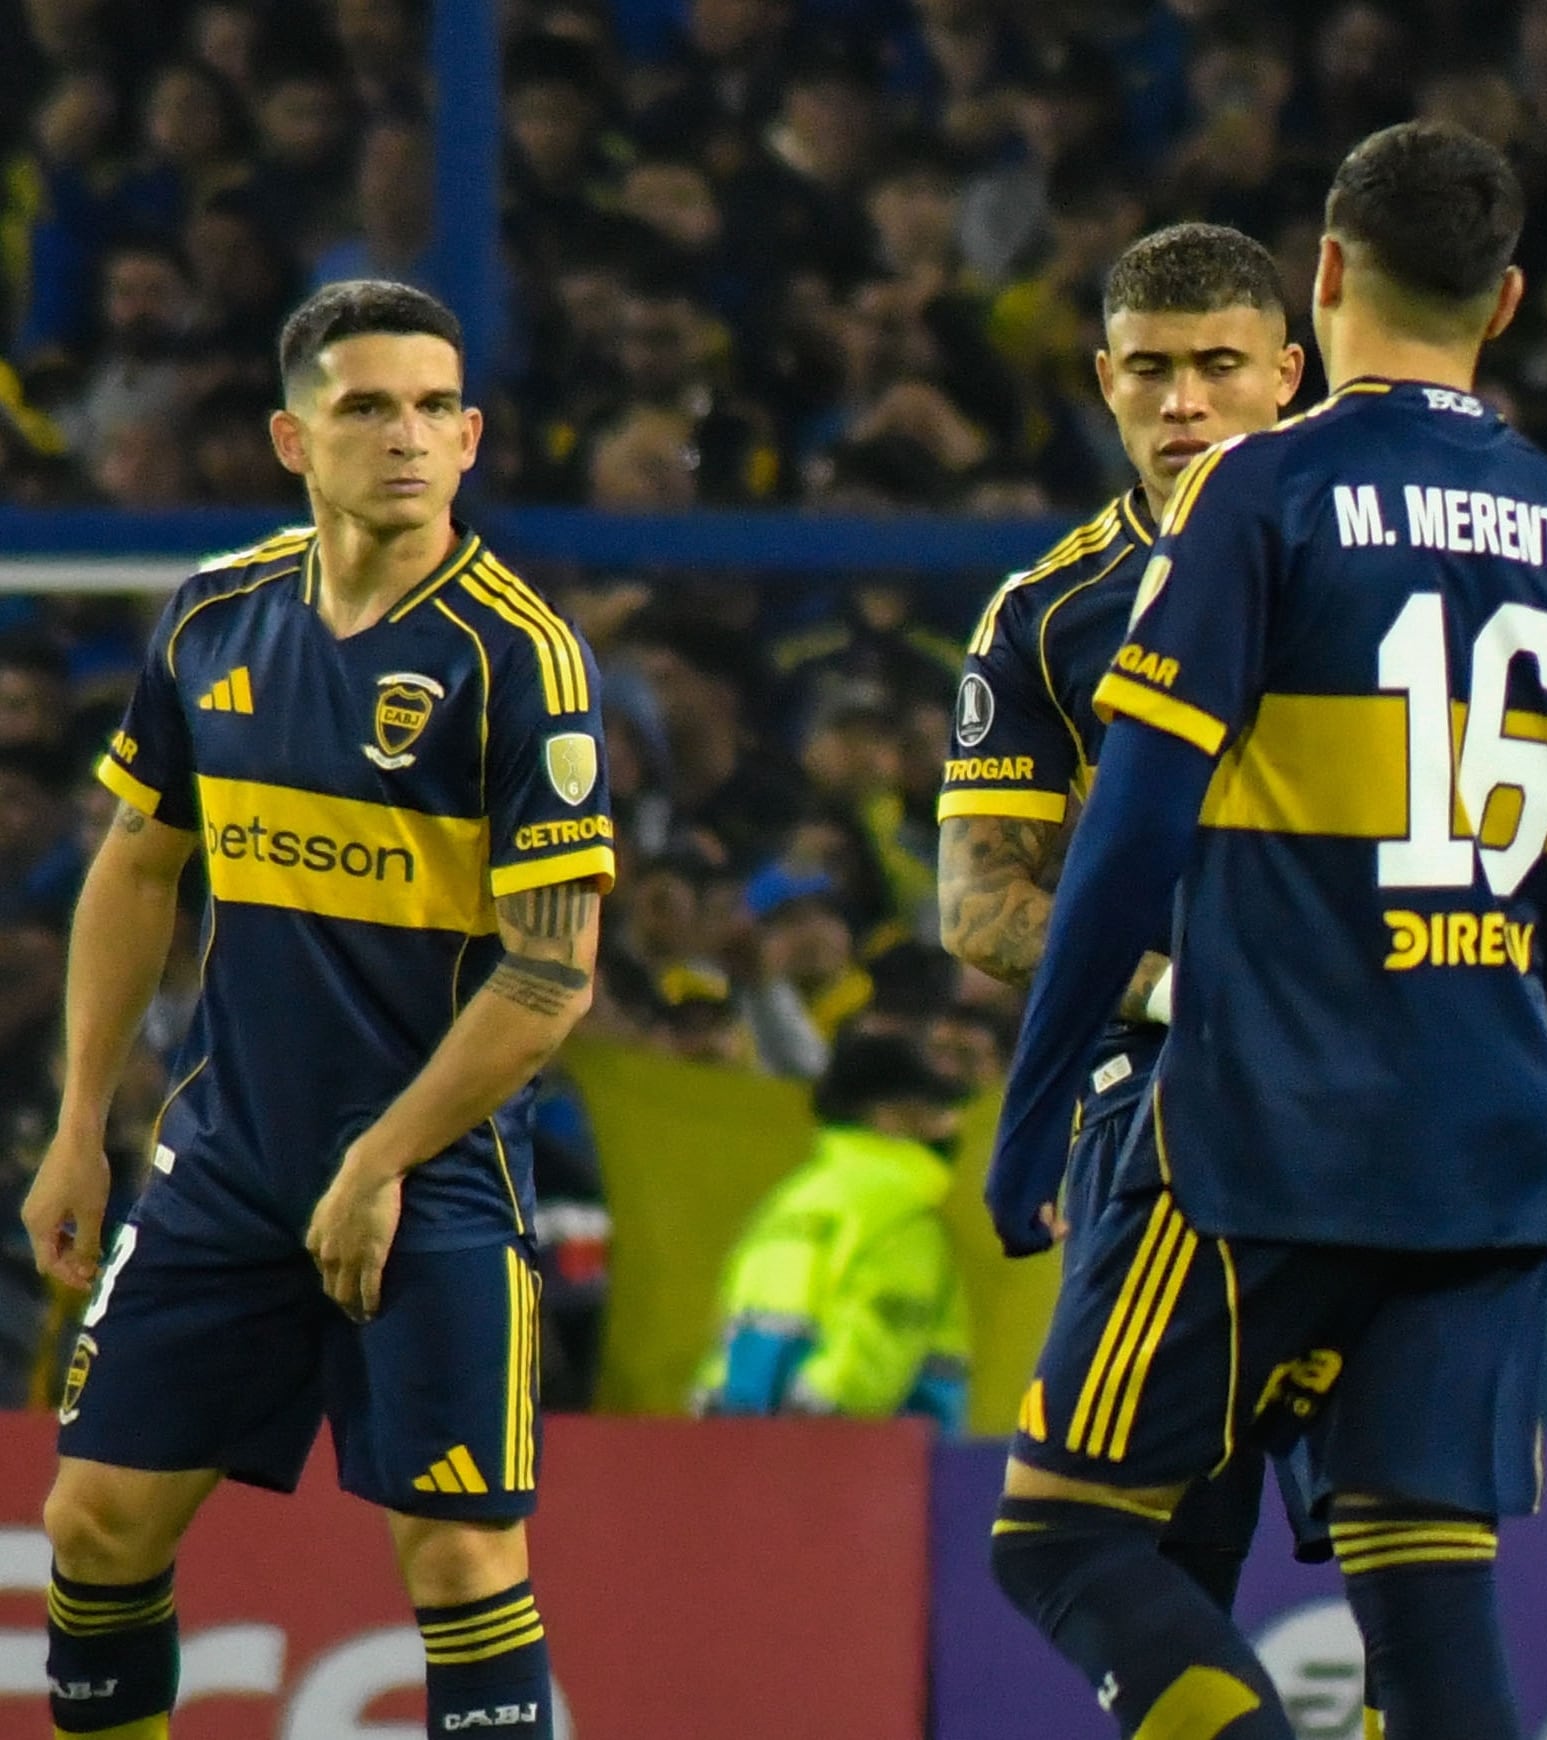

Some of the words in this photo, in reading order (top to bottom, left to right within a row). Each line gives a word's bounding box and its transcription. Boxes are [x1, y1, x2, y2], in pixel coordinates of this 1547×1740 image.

[1333, 484, 1397, 548] M.
[383, 708, 422, 728] CABJ
[568, 781, 580, 797] 6
[444, 1702, 538, 1732] CABJ
